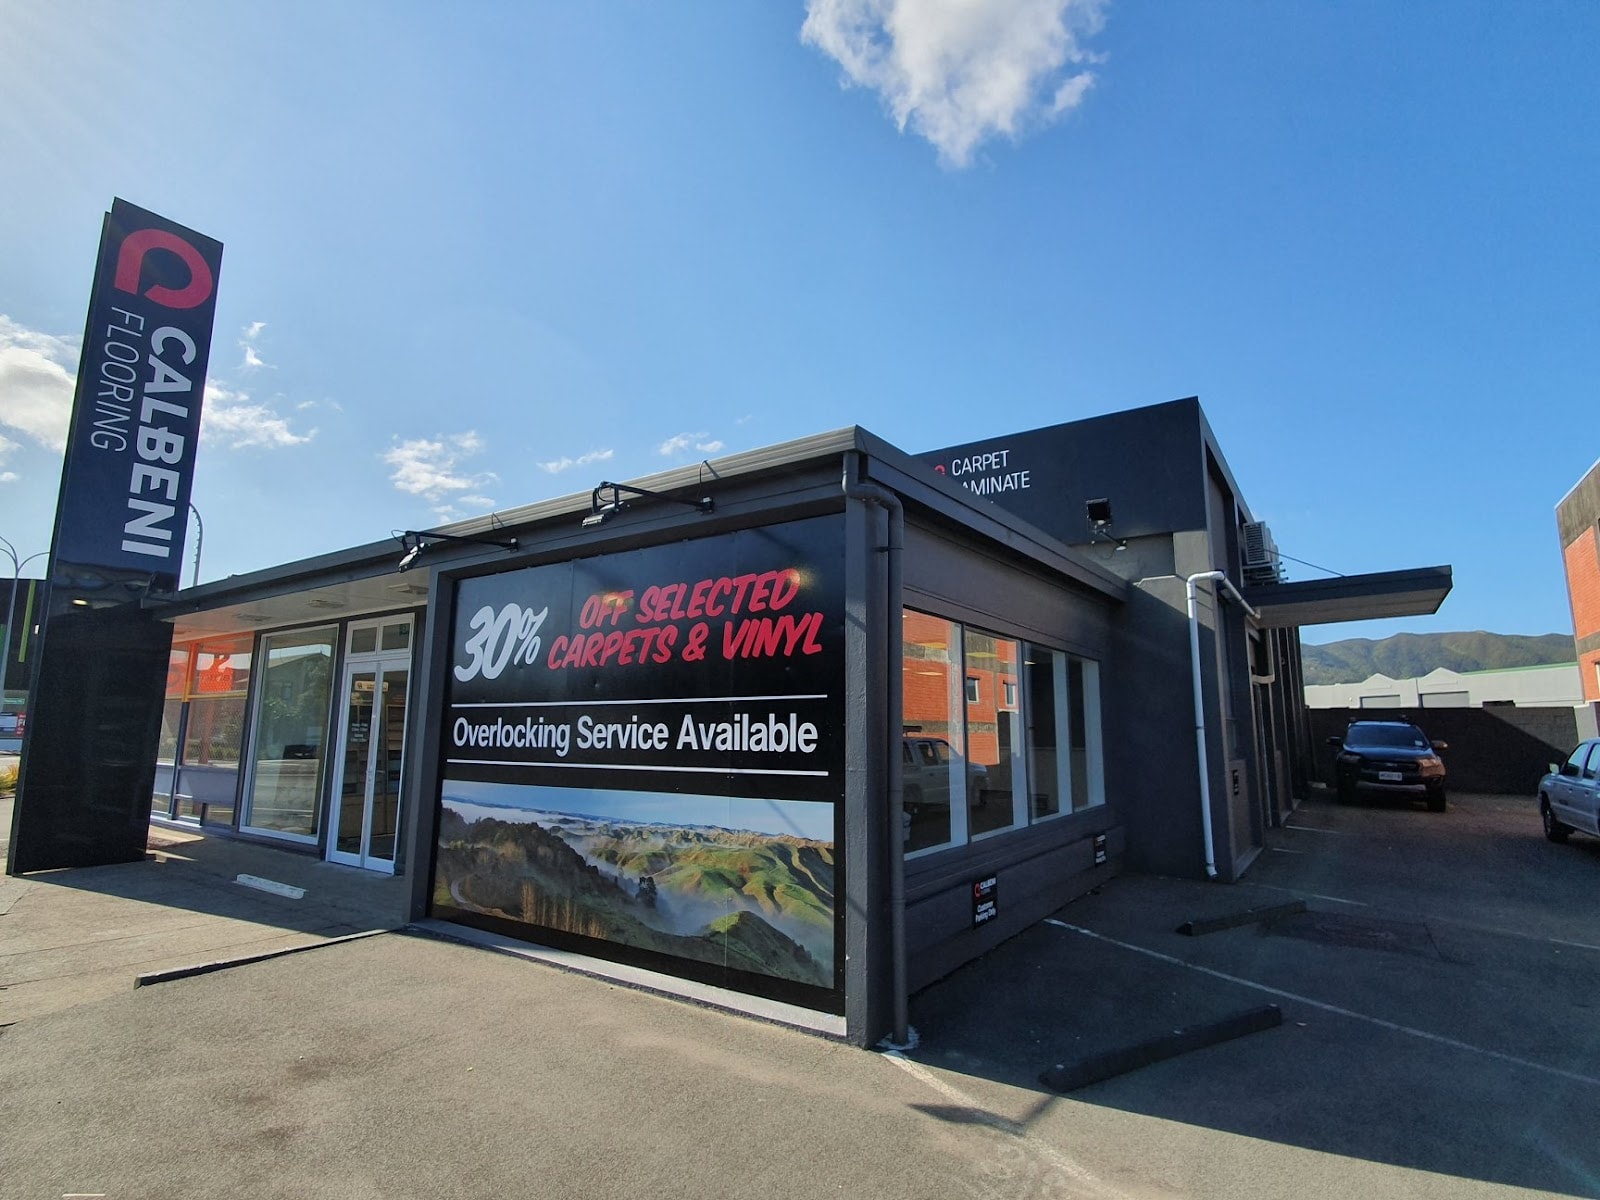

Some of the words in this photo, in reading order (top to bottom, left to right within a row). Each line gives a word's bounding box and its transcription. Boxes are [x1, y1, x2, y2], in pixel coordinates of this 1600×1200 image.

[91, 306, 145, 453] FLOORING
[121, 326, 197, 559] CALBENI
[951, 449, 1010, 476] CARPET
[579, 591, 634, 630] OFF
[635, 568, 800, 623] SELECTED
[453, 602, 549, 682] 30%
[548, 622, 677, 670] CARPETS
[682, 622, 710, 661] &
[722, 612, 825, 660] VINYL
[452, 716, 570, 757] Overlocking
[576, 714, 669, 750] Service
[676, 712, 818, 753] Available
